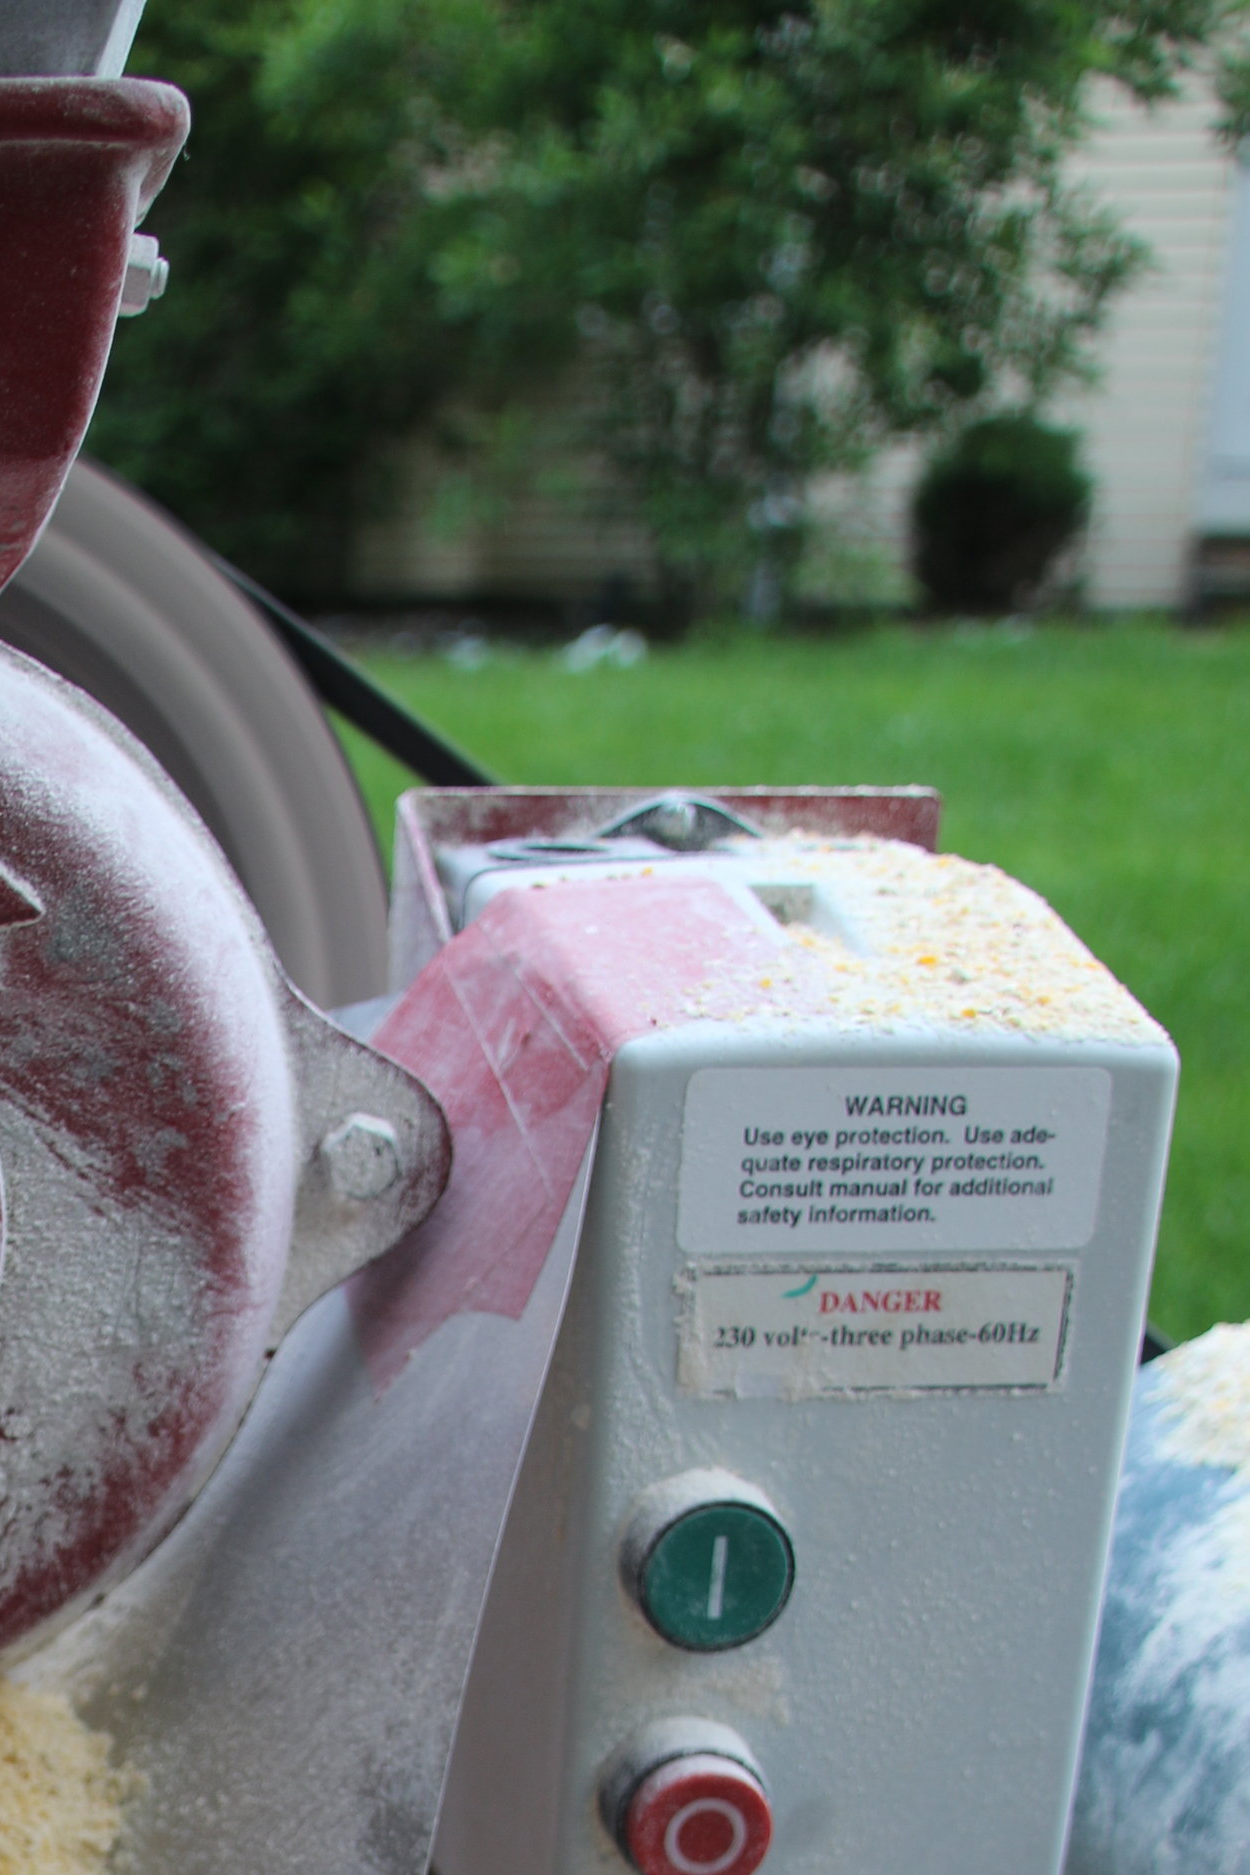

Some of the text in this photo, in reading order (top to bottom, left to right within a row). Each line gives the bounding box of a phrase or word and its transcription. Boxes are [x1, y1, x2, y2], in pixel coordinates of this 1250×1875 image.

[845, 1095, 967, 1117] WARNING
[744, 1125, 1056, 1150] Use eye protection. Use ade-
[741, 1151, 1045, 1176] quate respiratory protection.
[739, 1176, 1054, 1198] Consult manual for additional
[737, 1204, 936, 1229] safety information.
[819, 1289, 942, 1314] DANGER
[714, 1320, 1041, 1351] 230 vol-three phase-60Hz
